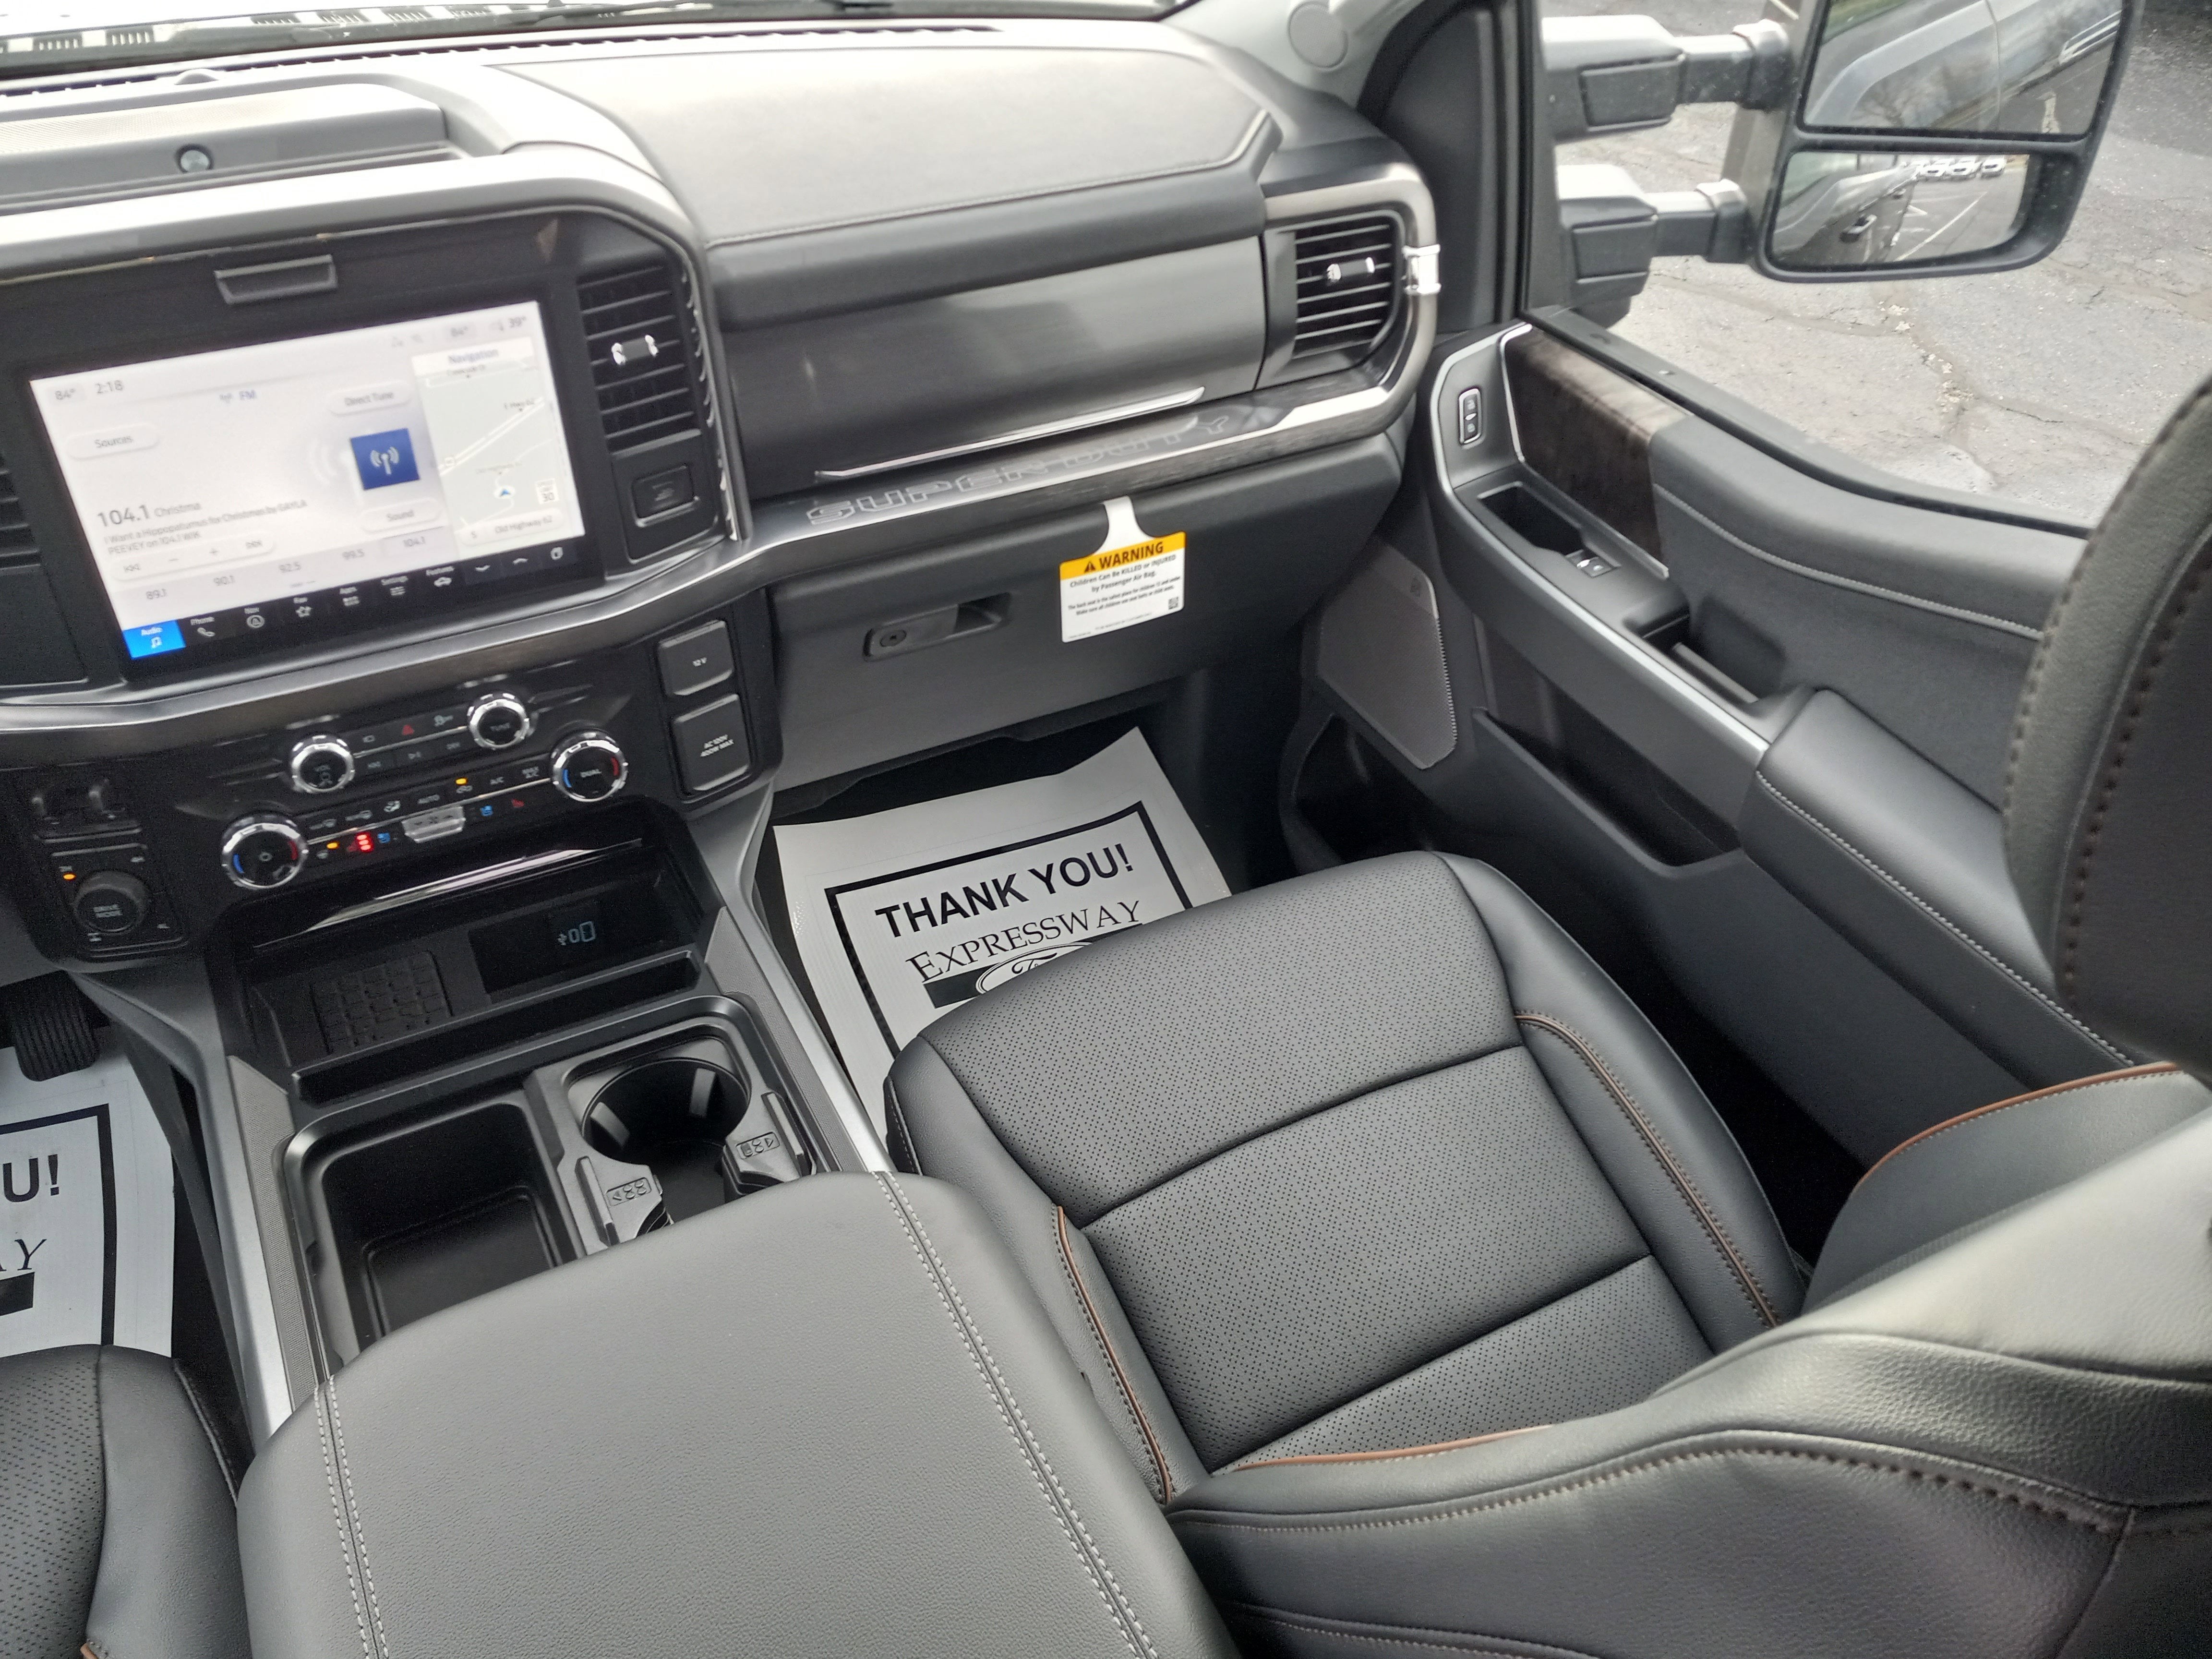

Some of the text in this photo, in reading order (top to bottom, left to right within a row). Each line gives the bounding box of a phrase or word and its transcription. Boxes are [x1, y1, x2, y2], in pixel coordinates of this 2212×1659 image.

[448, 349, 498, 364] Navigation
[95, 380, 125, 395] 2:18
[344, 395, 372, 406] Direct
[94, 435, 133, 449] Sources
[806, 415, 1230, 525] SUPER DUTY
[98, 505, 150, 527] 104.1
[386, 509, 415, 522] Sound
[403, 536, 426, 548] 104.1
[1099, 541, 1164, 569] WARNING
[279, 561, 301, 573] 92.5
[1070, 577, 1097, 588] Children
[1121, 565, 1142, 575] KILLED
[1151, 554, 1177, 567] INJURED
[213, 575, 235, 586] 90.1
[1101, 577, 1132, 590] Passenger
[146, 588, 167, 600] 89.1
[875, 842, 1135, 938] THANK YOU!
[905, 899, 1142, 983] EXPRESSWAY
[2, 1154, 60, 1202] U!
